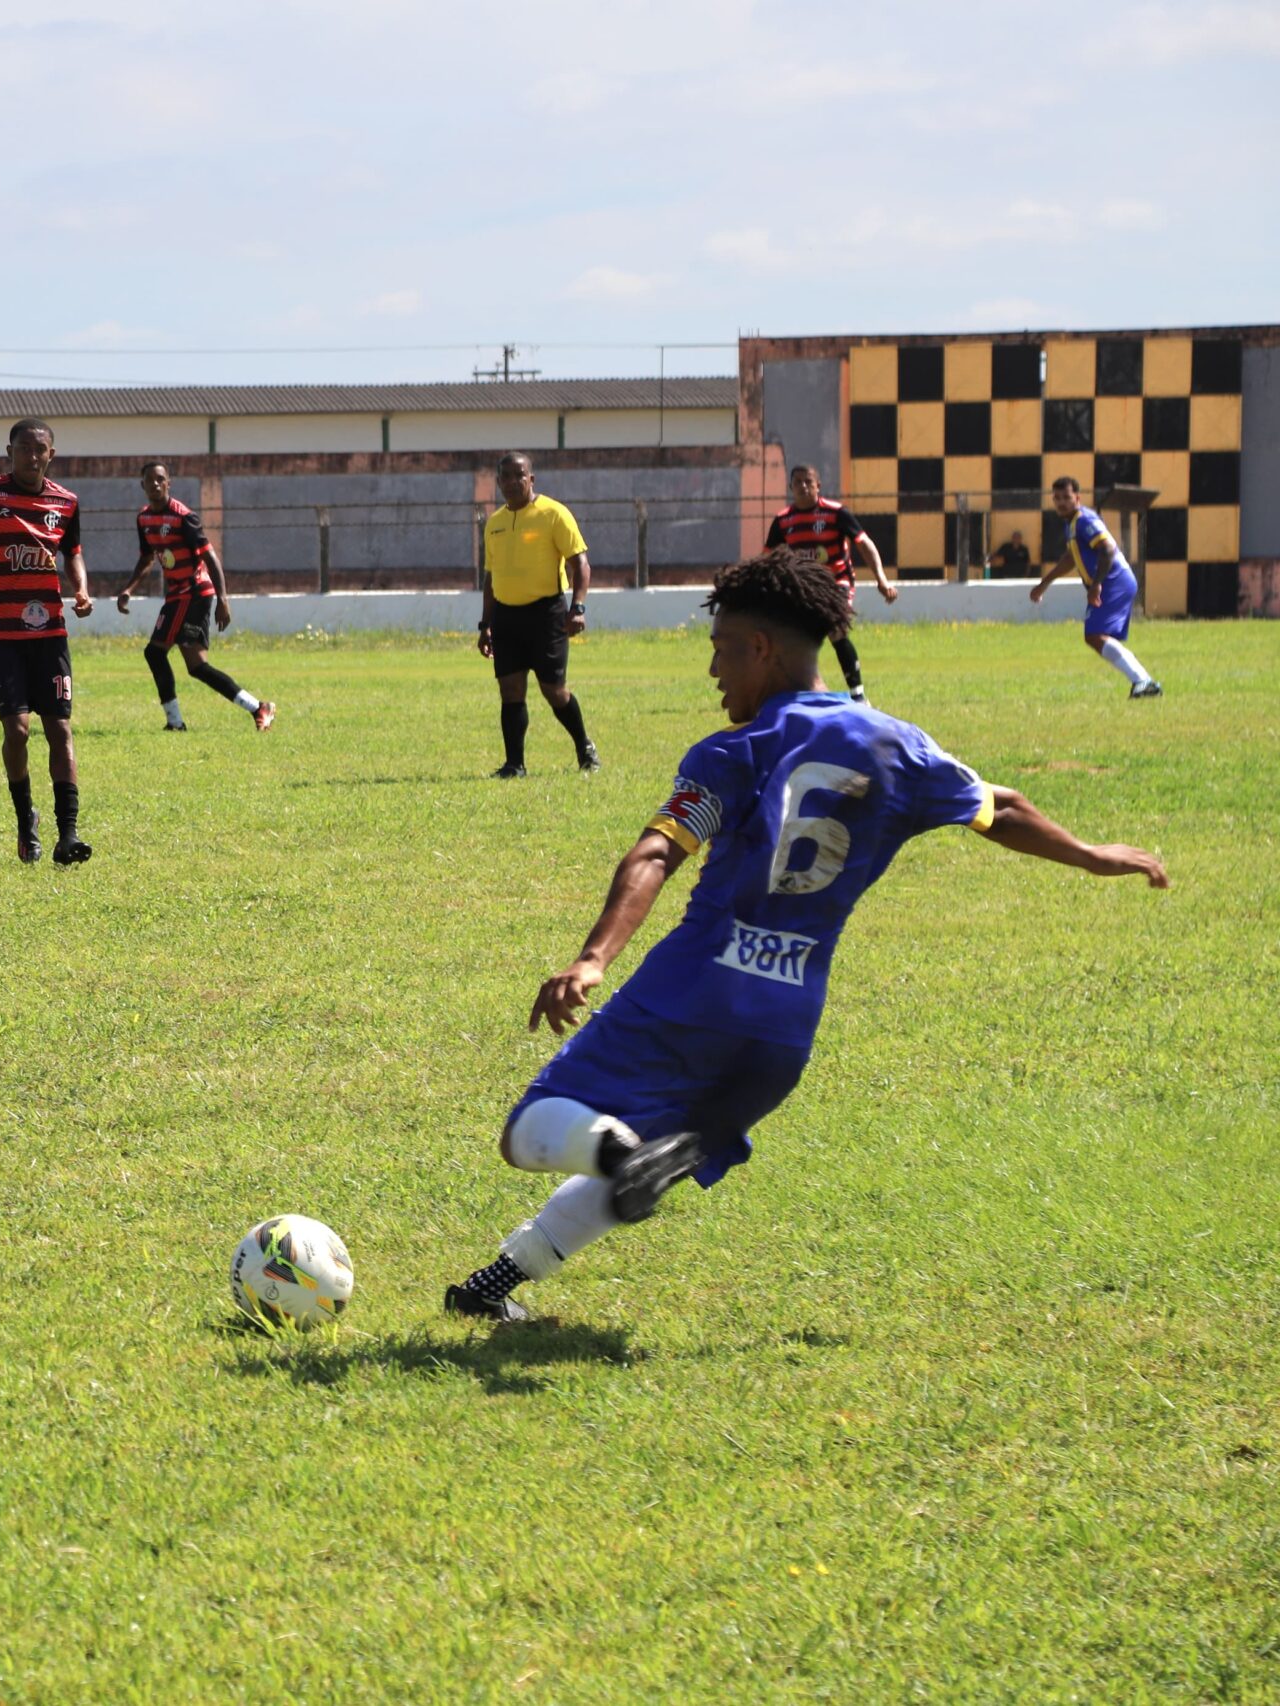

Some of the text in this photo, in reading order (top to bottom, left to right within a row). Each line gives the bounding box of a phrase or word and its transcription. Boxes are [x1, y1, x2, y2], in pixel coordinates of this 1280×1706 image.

[52, 675, 72, 700] 19
[768, 761, 870, 895] 6
[232, 1247, 247, 1307] pper
